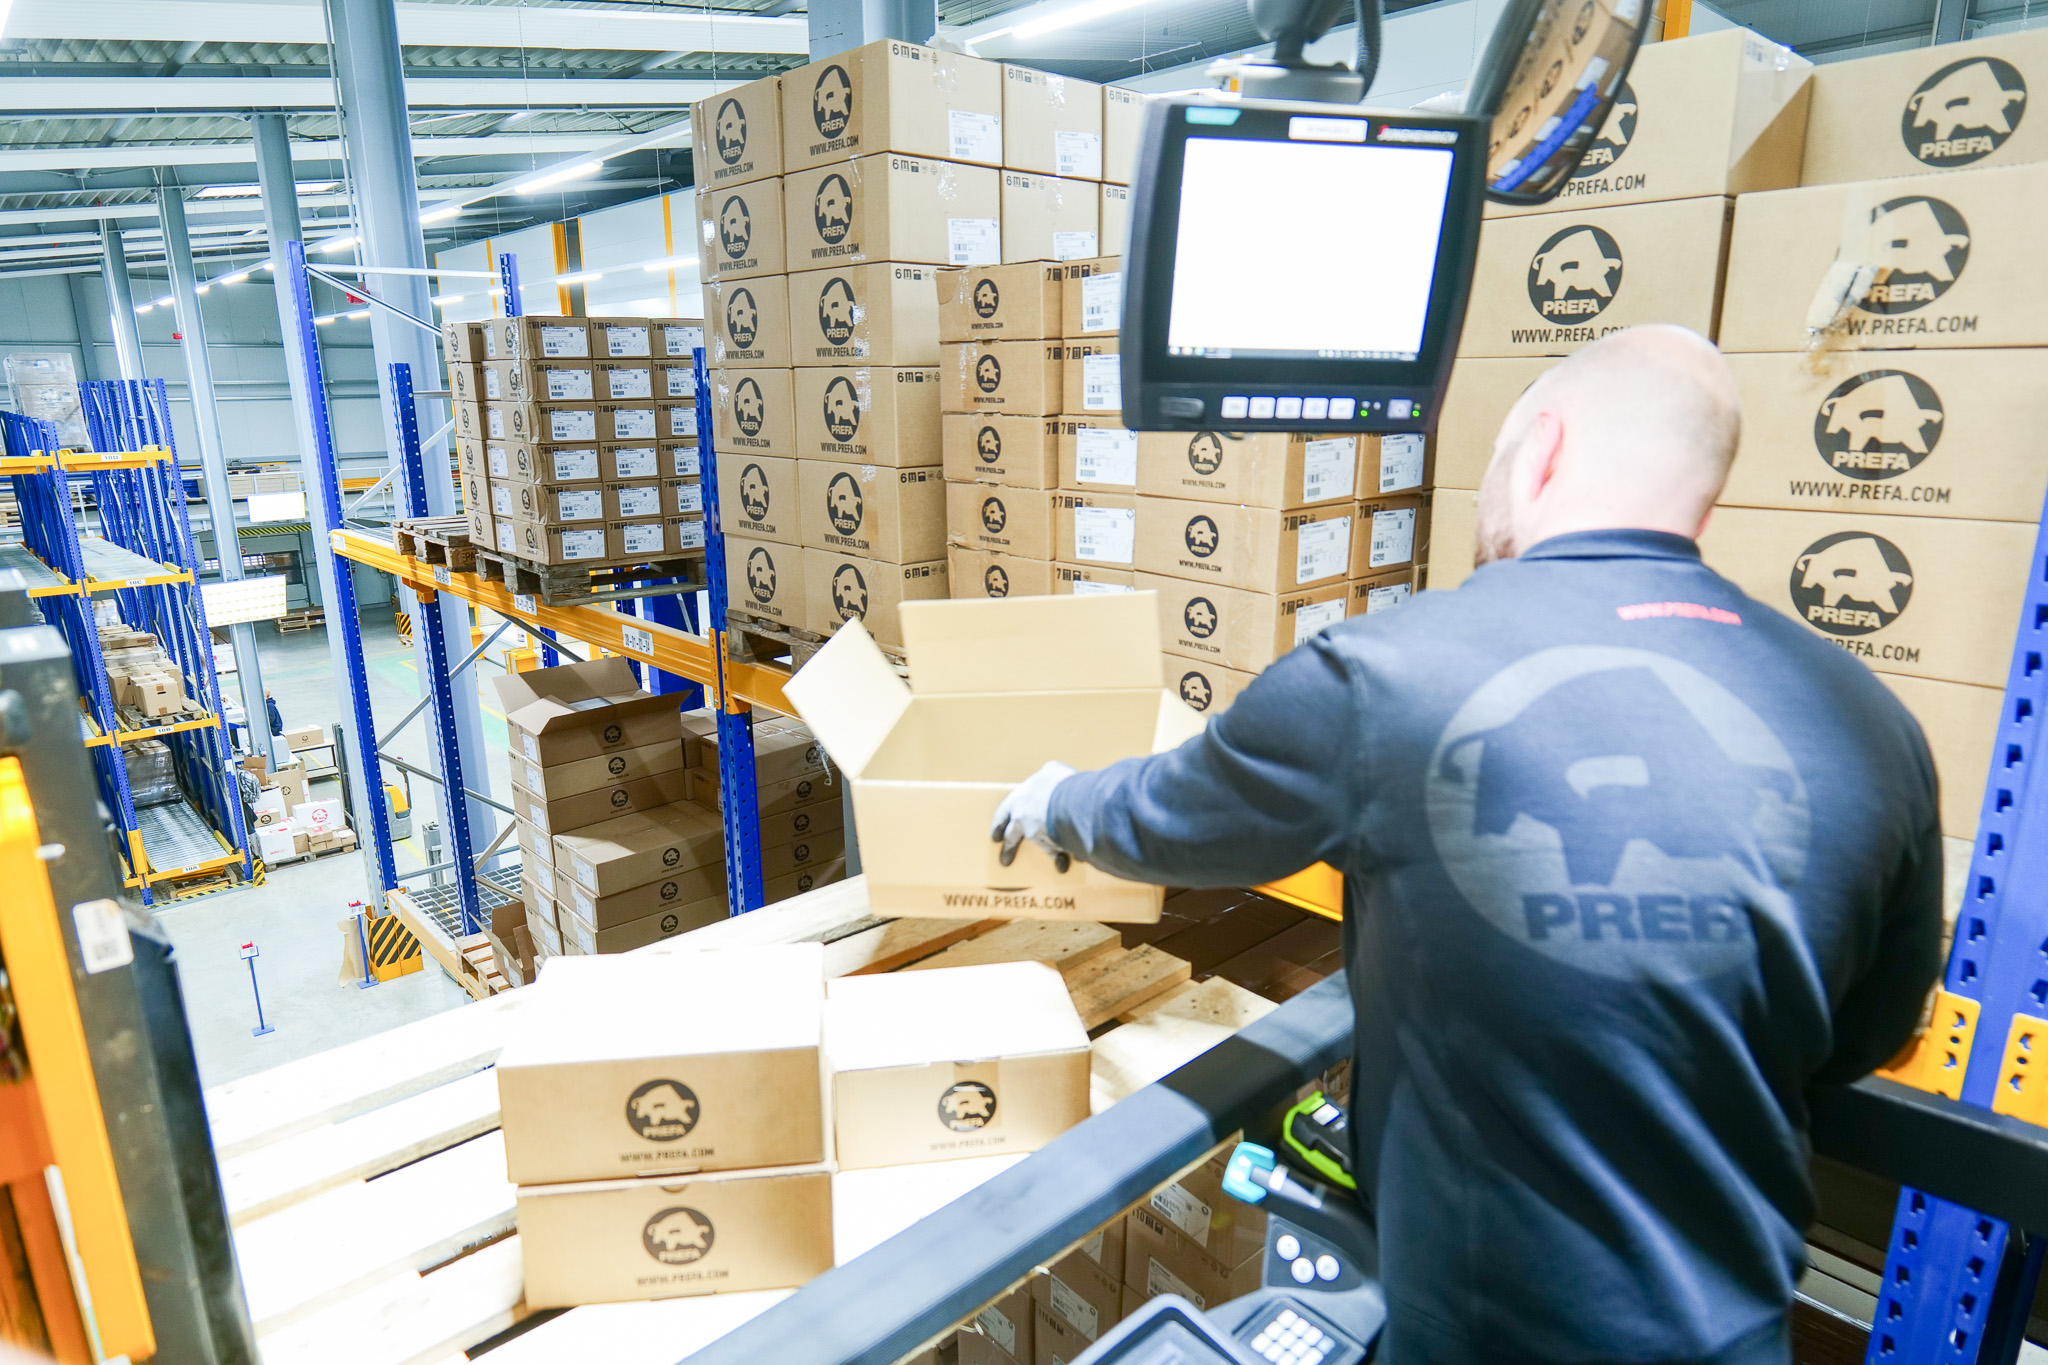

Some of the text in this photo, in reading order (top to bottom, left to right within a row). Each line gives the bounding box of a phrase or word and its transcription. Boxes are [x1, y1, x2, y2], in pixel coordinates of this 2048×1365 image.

[821, 117, 845, 133] PREFA
[722, 146, 742, 159] PREFA
[809, 135, 859, 156] WWW.PREFA.COM
[1919, 135, 1994, 160] PREFA
[1579, 147, 1614, 166] EFA
[714, 161, 754, 179] WWW.PREFA.COM
[1556, 173, 1646, 198] .PREFA.COM
[822, 226, 846, 238] PREFA
[727, 242, 746, 253] PREFA
[811, 243, 860, 259] WWW.PREFA.COM
[719, 258, 758, 272] WWW.PREFA.COM
[1866, 282, 1937, 303] REFA
[1542, 298, 1600, 315] PREFA
[826, 327, 850, 338] PREFA
[1848, 316, 1978, 336] W.PREFA.COM
[734, 332, 753, 342] PREFA
[726, 350, 764, 359] WWW.PREFA.COM
[740, 421, 759, 431] PREFA
[831, 424, 853, 436] PREFA
[732, 437, 771, 448] WWW.PREFA.COM
[820, 442, 867, 455] WWW.PREFA.COM
[1832, 451, 1910, 470] PREFA
[1790, 481, 1951, 503] WWW.PREFA.COM
[746, 505, 765, 516] PREFA
[738, 519, 776, 534] WWW.PREFA.COM
[834, 518, 856, 530] PREFA
[824, 533, 870, 550] WWW.PREFA.COM
[753, 586, 772, 599] PREFA
[745, 600, 783, 617] WWW.PREFA.COM
[1807, 605, 1881, 629] PREFA
[943, 894, 1076, 910] WWW.PREFA.COM
